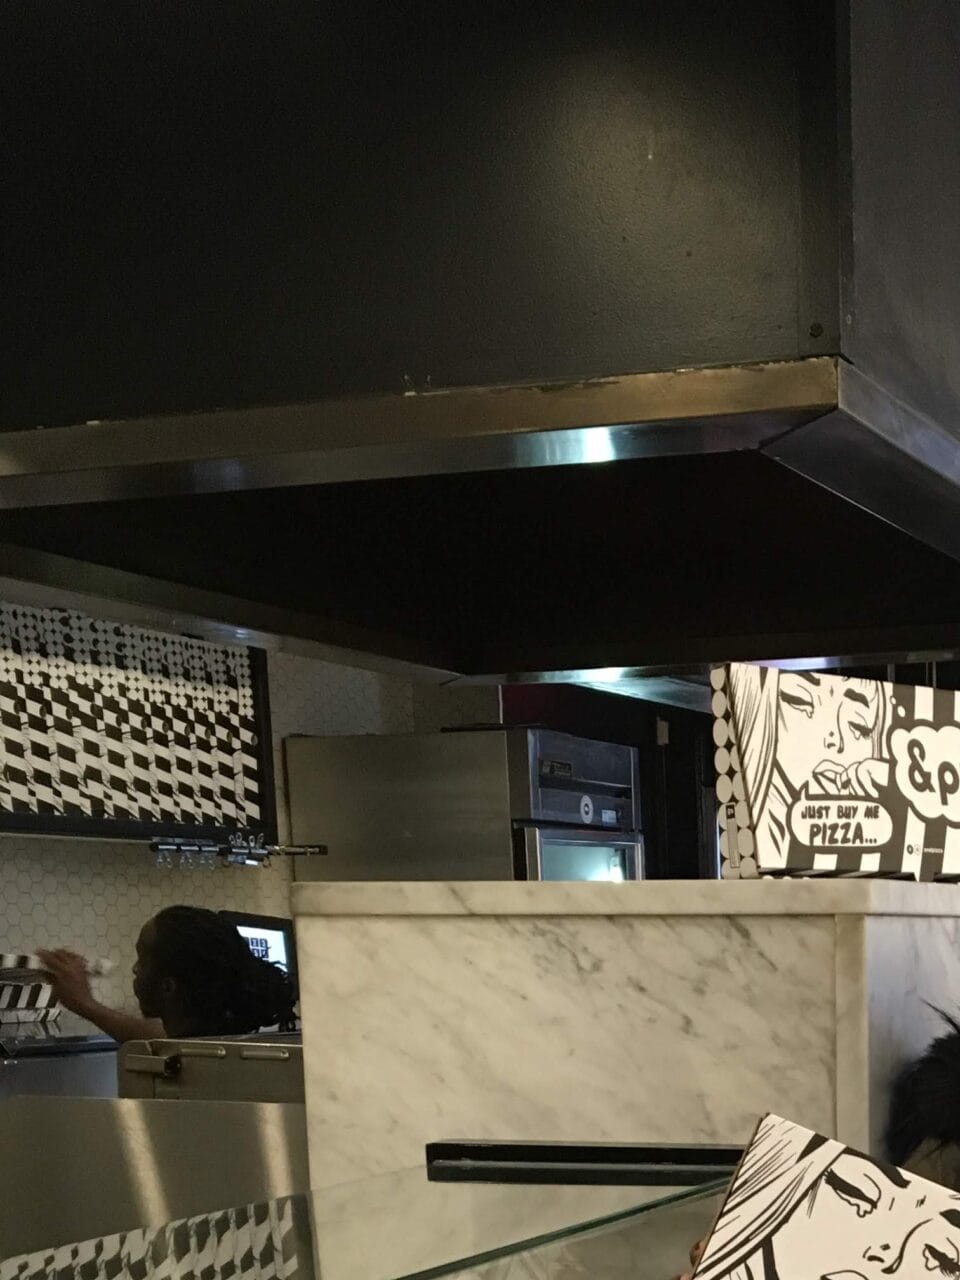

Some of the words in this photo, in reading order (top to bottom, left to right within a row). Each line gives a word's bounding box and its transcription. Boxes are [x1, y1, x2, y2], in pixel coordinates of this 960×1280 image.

[801, 805, 831, 819] JUST
[836, 804, 858, 819] BUY
[864, 805, 880, 819] ME
